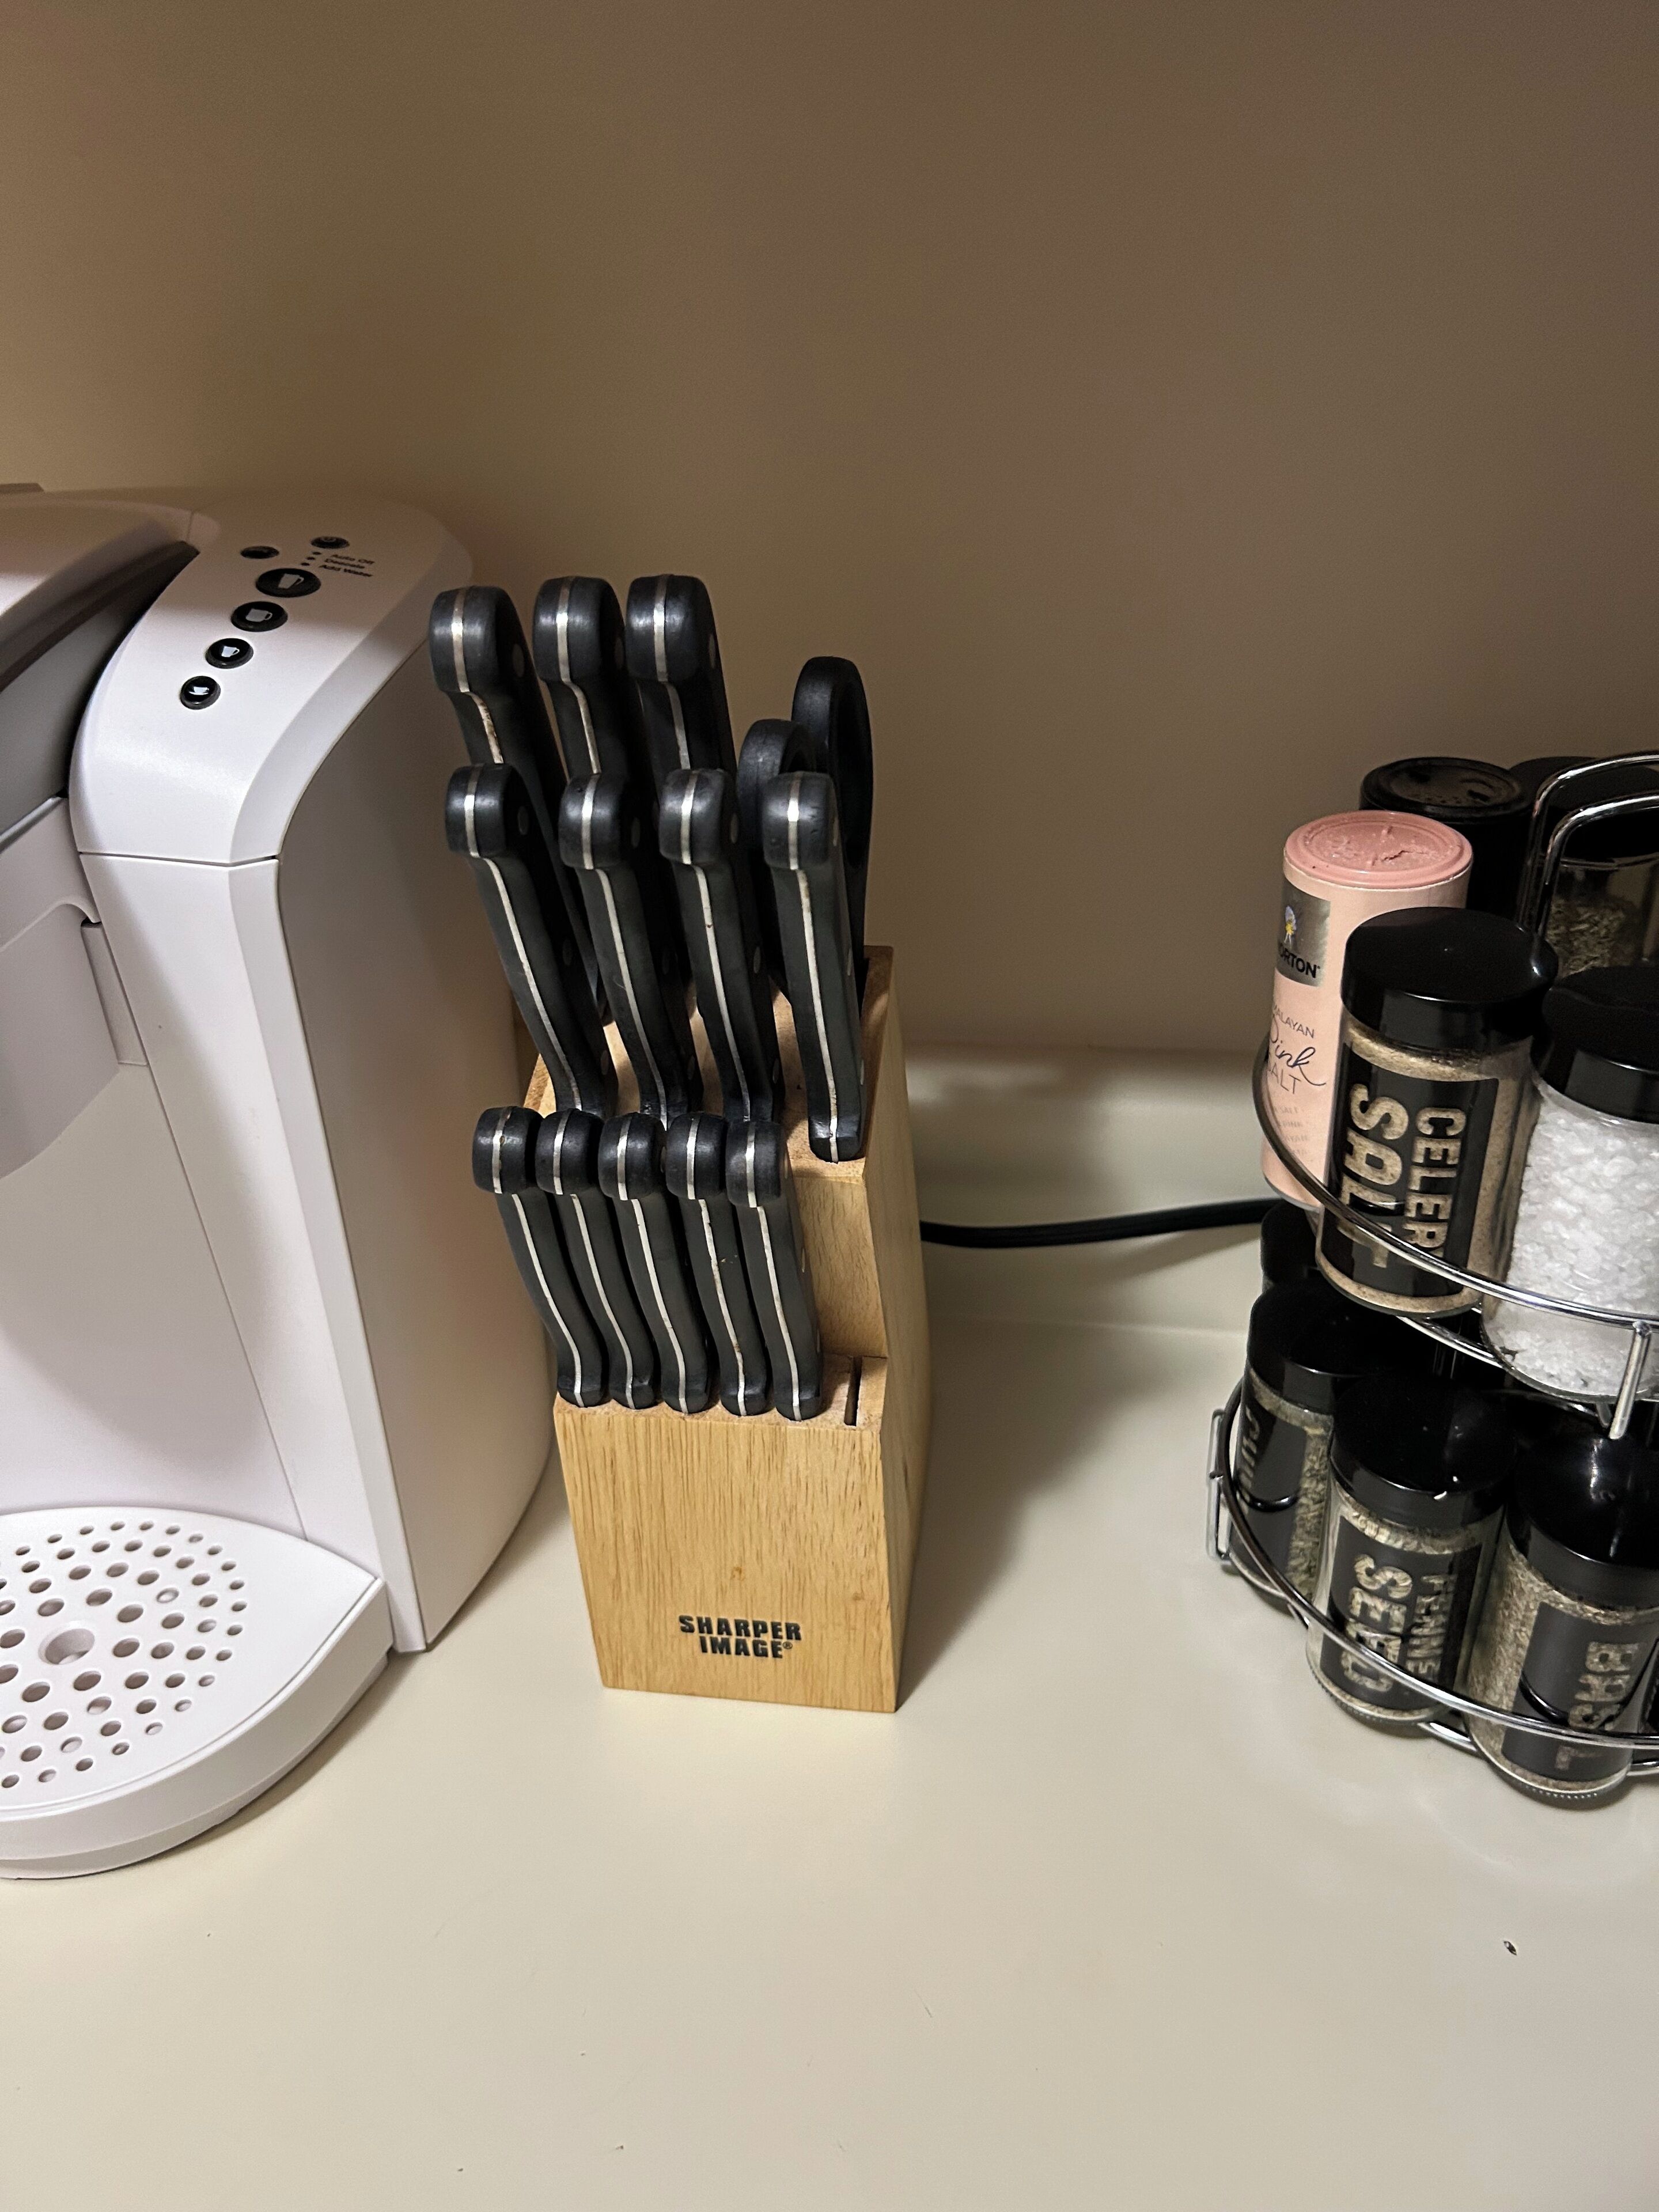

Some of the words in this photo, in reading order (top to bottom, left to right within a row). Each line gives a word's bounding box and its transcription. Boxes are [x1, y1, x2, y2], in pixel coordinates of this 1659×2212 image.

[1279, 943, 1317, 978] ORTON
[1274, 1005, 1315, 1039] ALAYAN
[1268, 1062, 1302, 1094] ALT
[1338, 1082, 1410, 1268] SALT
[1402, 1107, 1467, 1258] CELER
[679, 1615, 802, 1641] SHARPER
[1555, 1641, 1638, 1771] BASL
